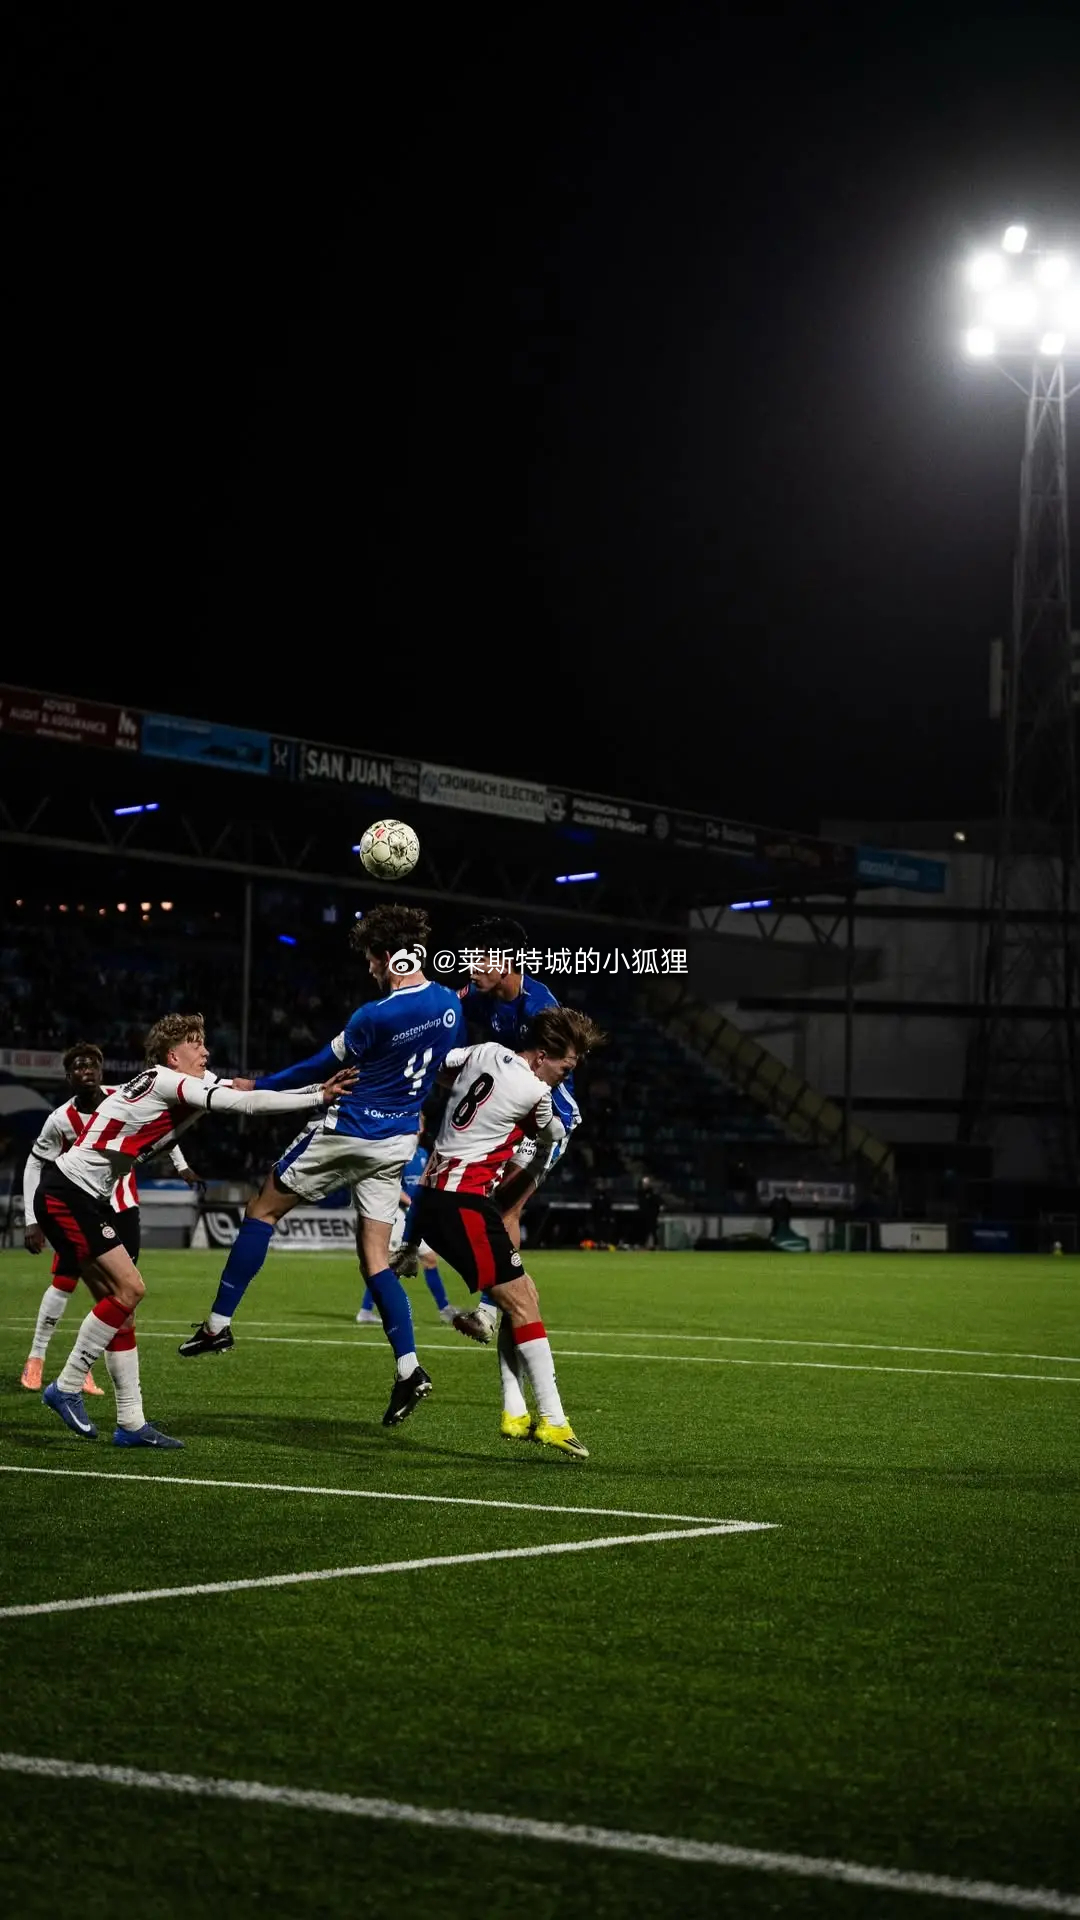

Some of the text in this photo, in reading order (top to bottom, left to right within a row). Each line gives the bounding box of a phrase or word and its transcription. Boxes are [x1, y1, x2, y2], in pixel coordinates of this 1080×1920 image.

[306, 748, 345, 782] SAN
[346, 755, 392, 791] JUAN
[438, 773, 498, 797] CROMBACH
[499, 784, 545, 805] ELECTRO
[392, 1017, 441, 1042] oostendorp
[403, 1047, 433, 1096] 4
[450, 1072, 495, 1131] 8
[274, 1217, 357, 1238] URTEEN
